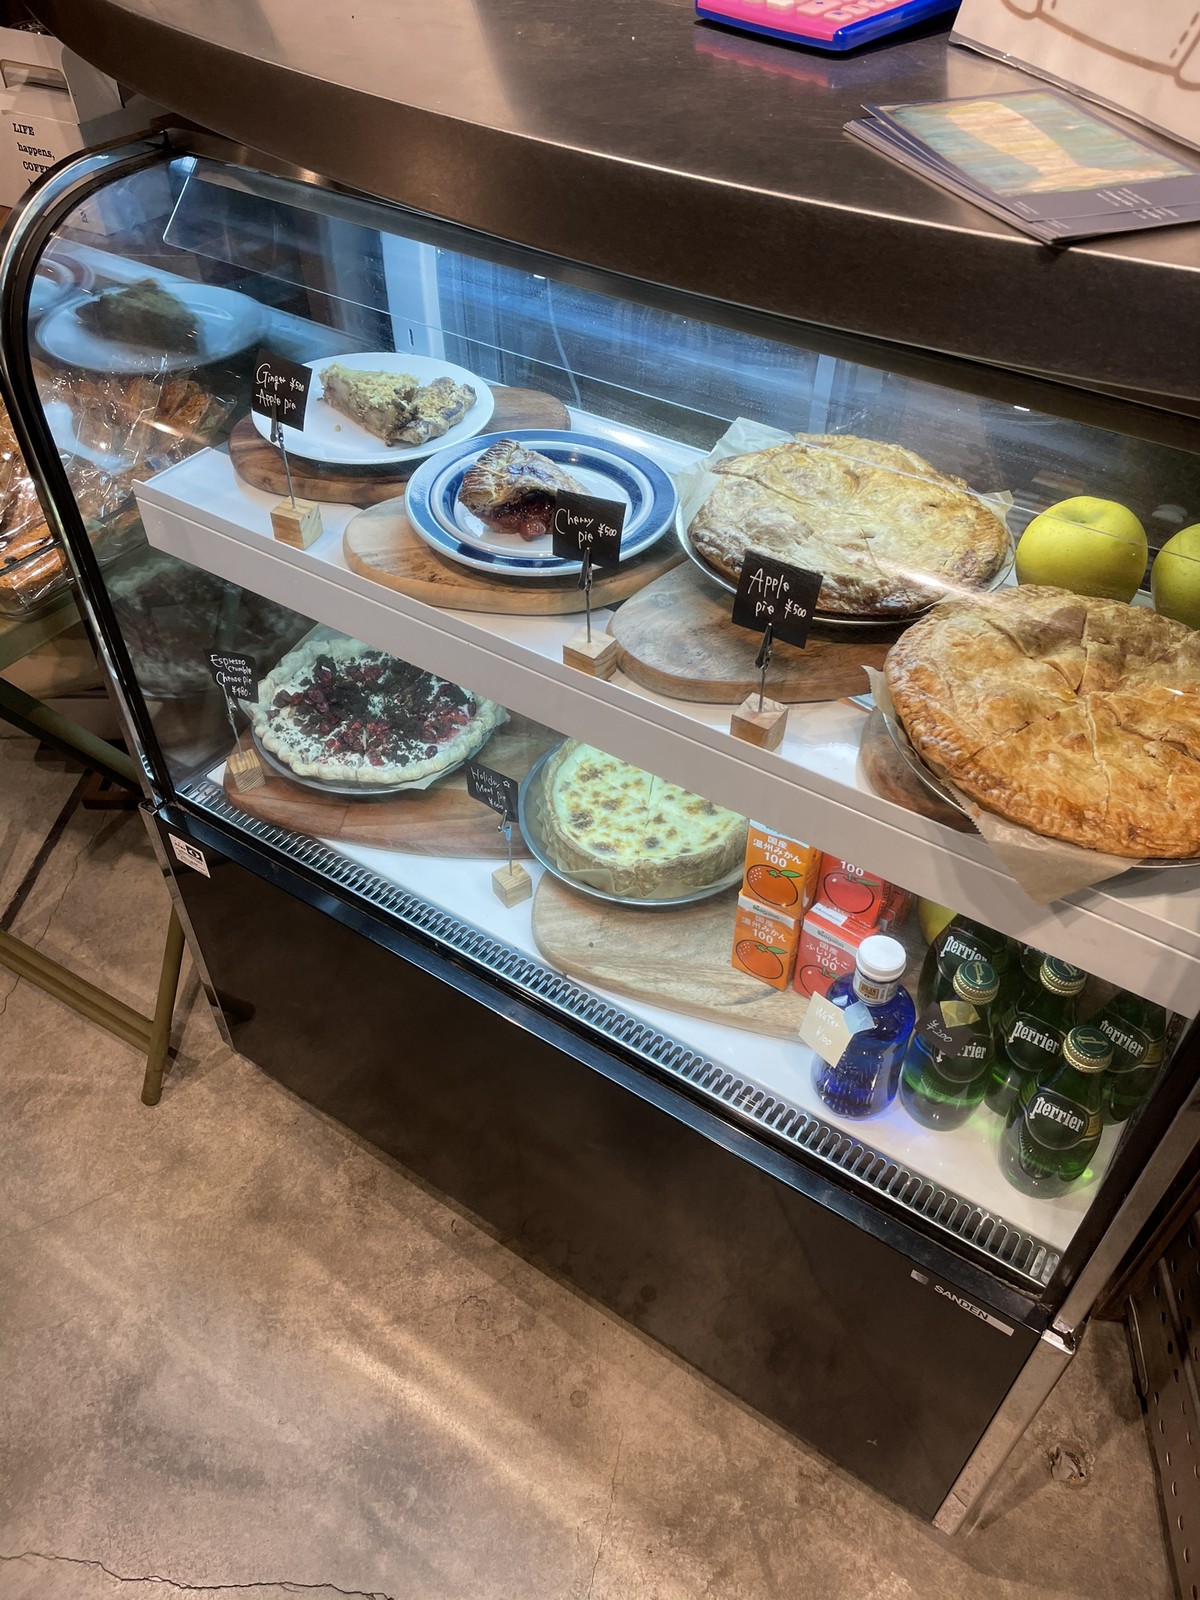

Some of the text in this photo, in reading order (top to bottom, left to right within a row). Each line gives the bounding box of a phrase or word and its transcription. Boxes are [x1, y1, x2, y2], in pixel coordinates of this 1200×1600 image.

[12, 122, 35, 136] LIFE
[16, 141, 56, 161] happens,
[255, 388, 281, 407] Apple
[554, 508, 618, 537] Cherry ¥500
[578, 531, 594, 549] pie
[747, 567, 790, 599] Apple
[755, 598, 807, 619] pie ¥500
[764, 851, 787, 868] 100
[840, 860, 864, 877] 100
[752, 928, 774, 945] 100
[815, 954, 838, 971] 100
[934, 1284, 989, 1320] SANDEN
